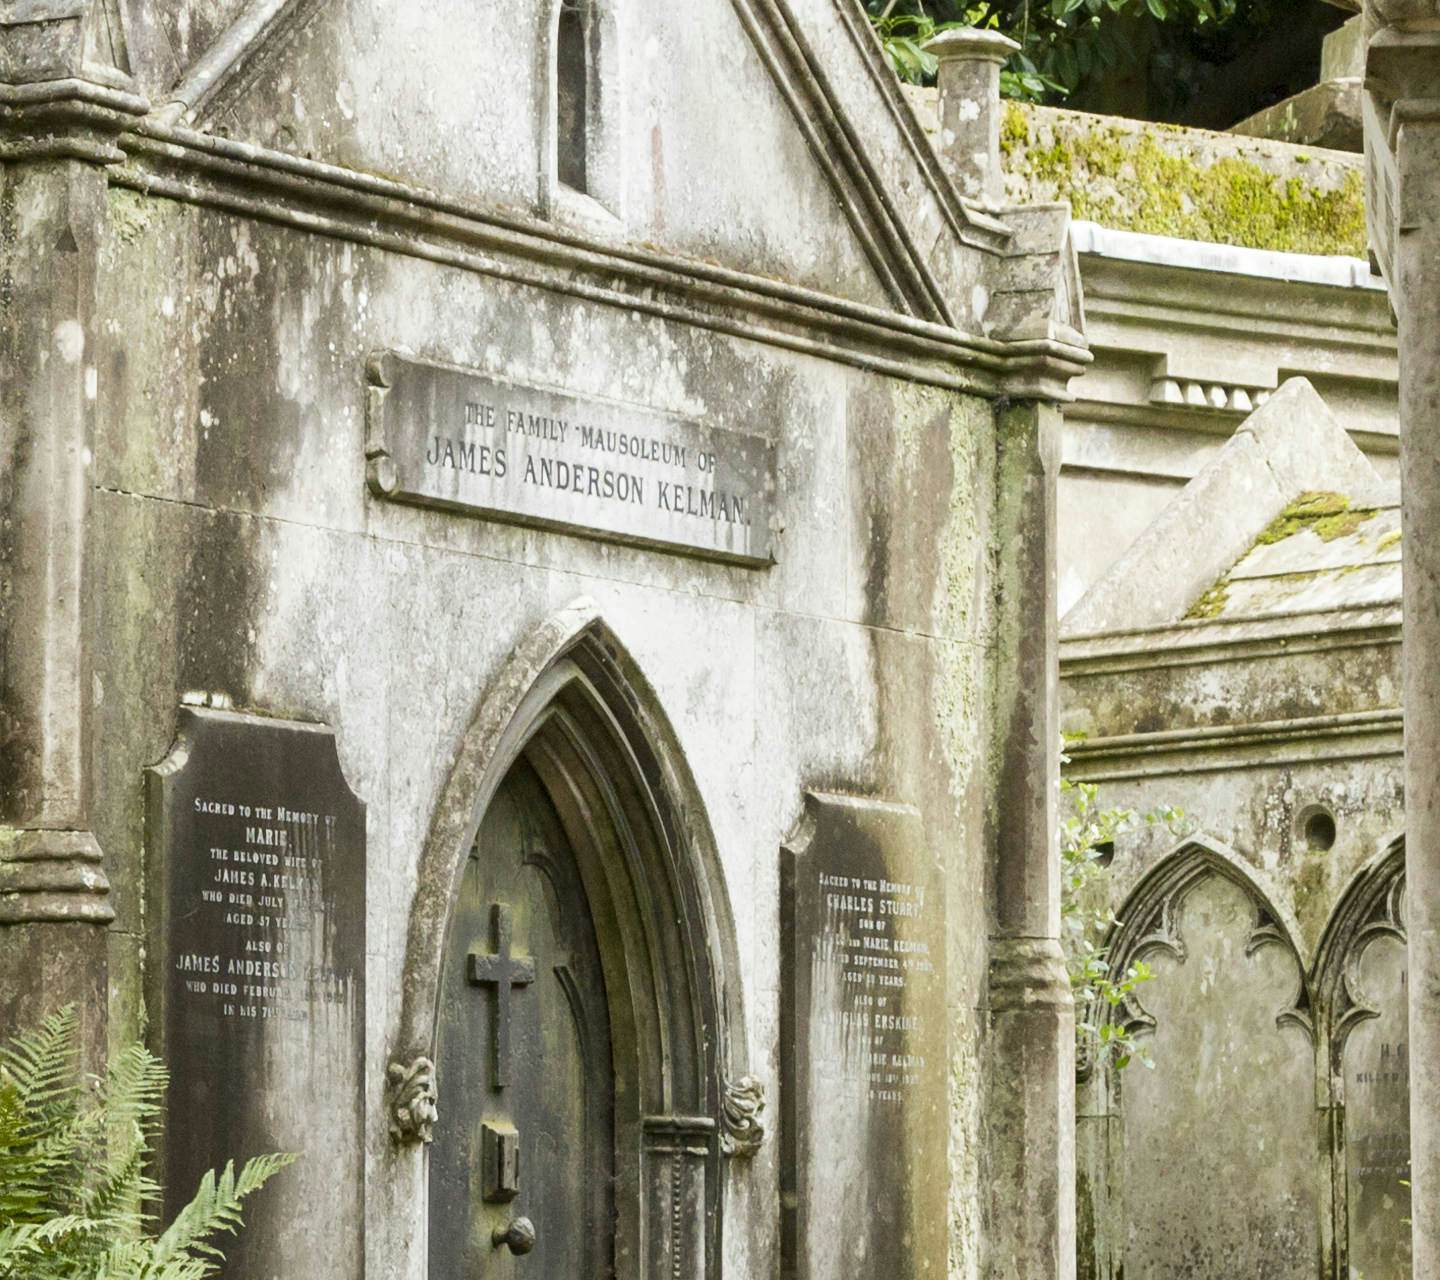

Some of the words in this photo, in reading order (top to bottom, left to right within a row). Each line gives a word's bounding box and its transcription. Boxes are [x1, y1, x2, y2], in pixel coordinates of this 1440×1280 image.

[464, 401, 495, 428] THE
[507, 410, 569, 443] FAMILY
[580, 426, 687, 468] MAUSOLEUM
[698, 452, 717, 473] OF
[426, 436, 507, 478] JAMES
[524, 455, 644, 504] ANDERSON
[210, 848, 228, 860] THE
[233, 851, 279, 865] BELOVED
[214, 869, 255, 886] JAMES
[202, 890, 222, 902] WHO
[229, 893, 253, 905] DIED
[258, 896, 284, 908] JULY
[827, 893, 874, 913] CHARLES
[226, 913, 253, 925] AGED
[246, 940, 272, 952] ALSO
[175, 954, 220, 973] JAMES
[854, 954, 899, 969] SEPTEMBER
[186, 980, 207, 993] WHO
[212, 983, 238, 995] DIED
